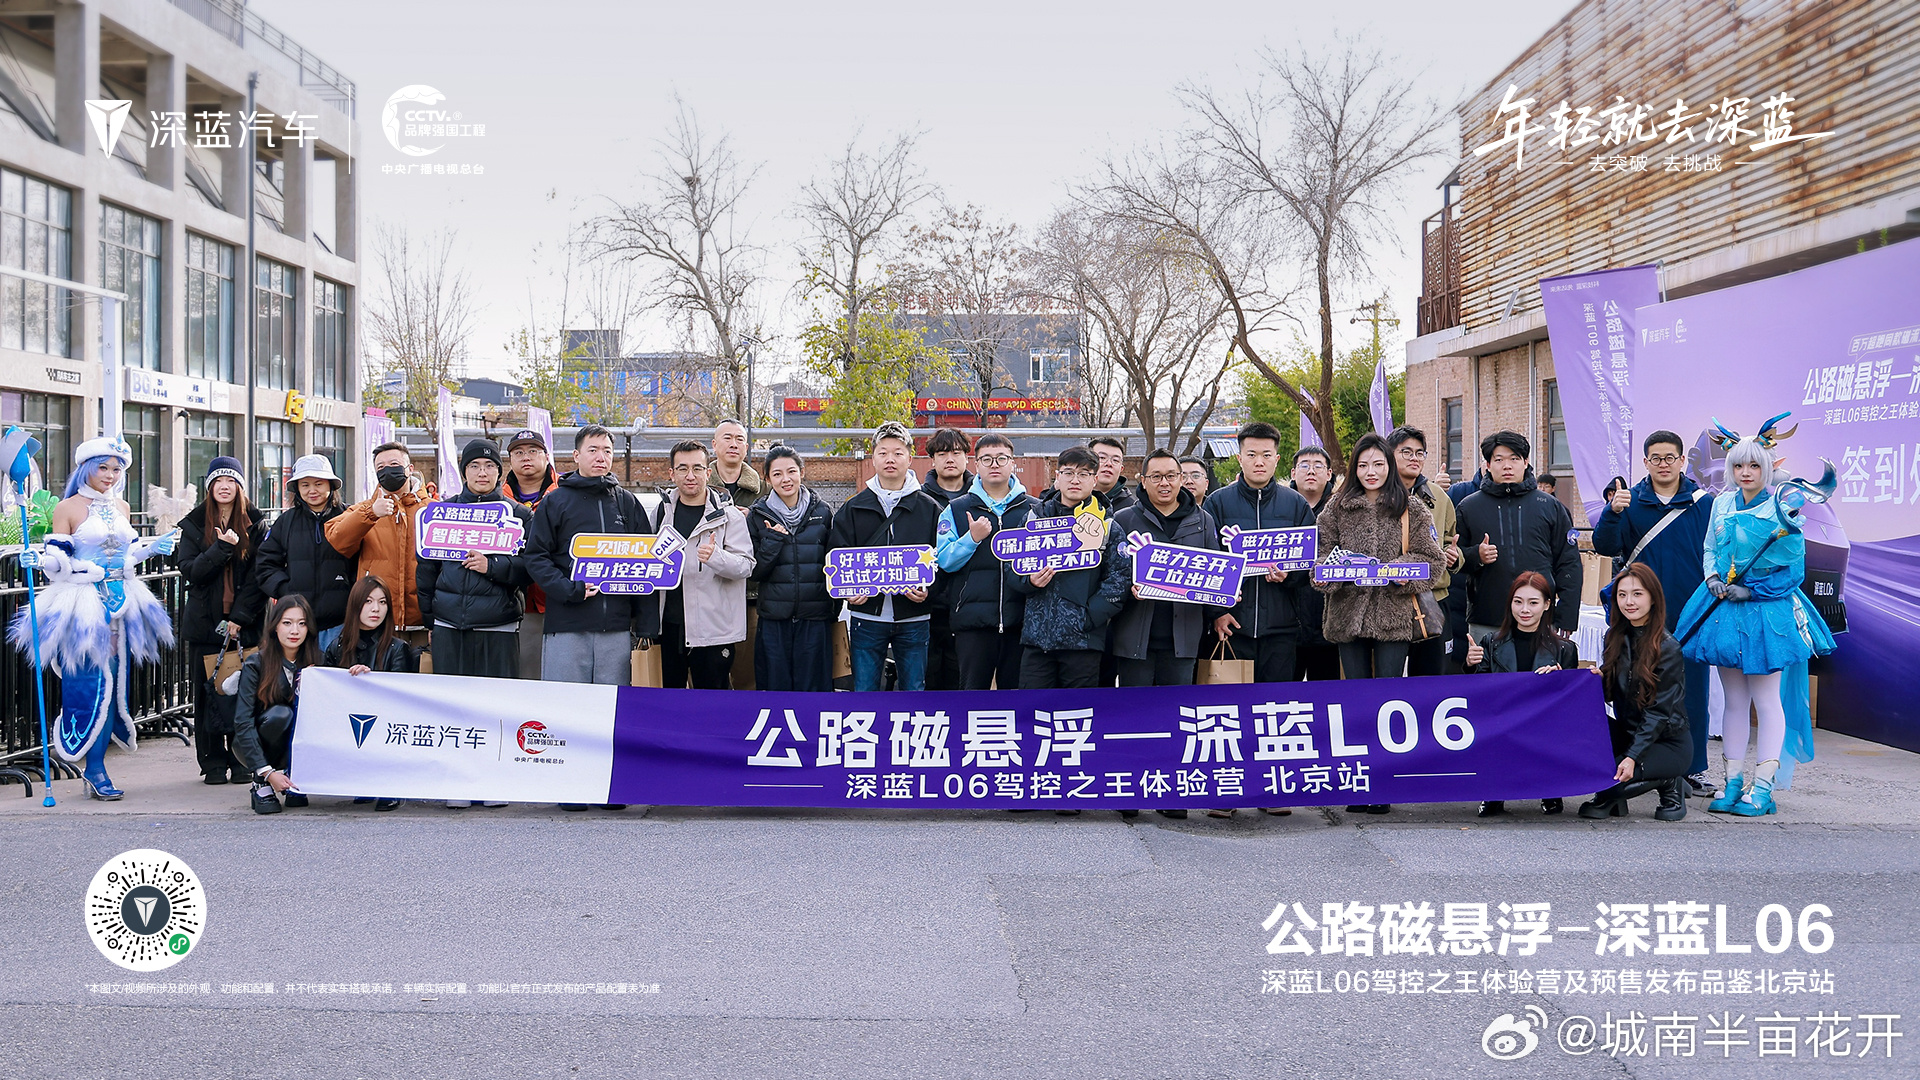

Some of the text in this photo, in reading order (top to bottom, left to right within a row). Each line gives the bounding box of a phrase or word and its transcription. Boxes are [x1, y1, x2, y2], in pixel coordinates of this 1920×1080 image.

[432, 506, 500, 524] 公路磁悬浮
[1033, 518, 1069, 530] 深蓝L06
[431, 527, 513, 549] 智能老司机
[655, 536, 676, 556] CALL
[1241, 532, 1304, 548] 磁力全开
[428, 549, 462, 559] 深蓝L06
[578, 540, 649, 556] 一见倾心
[839, 551, 904, 568] 好「紫」味
[1149, 548, 1230, 574] 磁力全开
[1282, 561, 1310, 570] 深蓝L06
[576, 561, 664, 579] 「智」控全局
[839, 567, 920, 585] 试试才知道
[1321, 567, 1368, 579] 引擎轰鸣
[608, 583, 645, 593] 深蓝L06
[837, 587, 871, 597] 深蓝L06
[1194, 592, 1228, 605] 深蓝L06
[385, 721, 487, 751] 深蓝汽车
[526, 738, 567, 747] 品牌强国工程
[514, 756, 565, 765] 中央广播电视总台
[845, 761, 1371, 800] 深蓝L06驾控之王体验营 北京站
